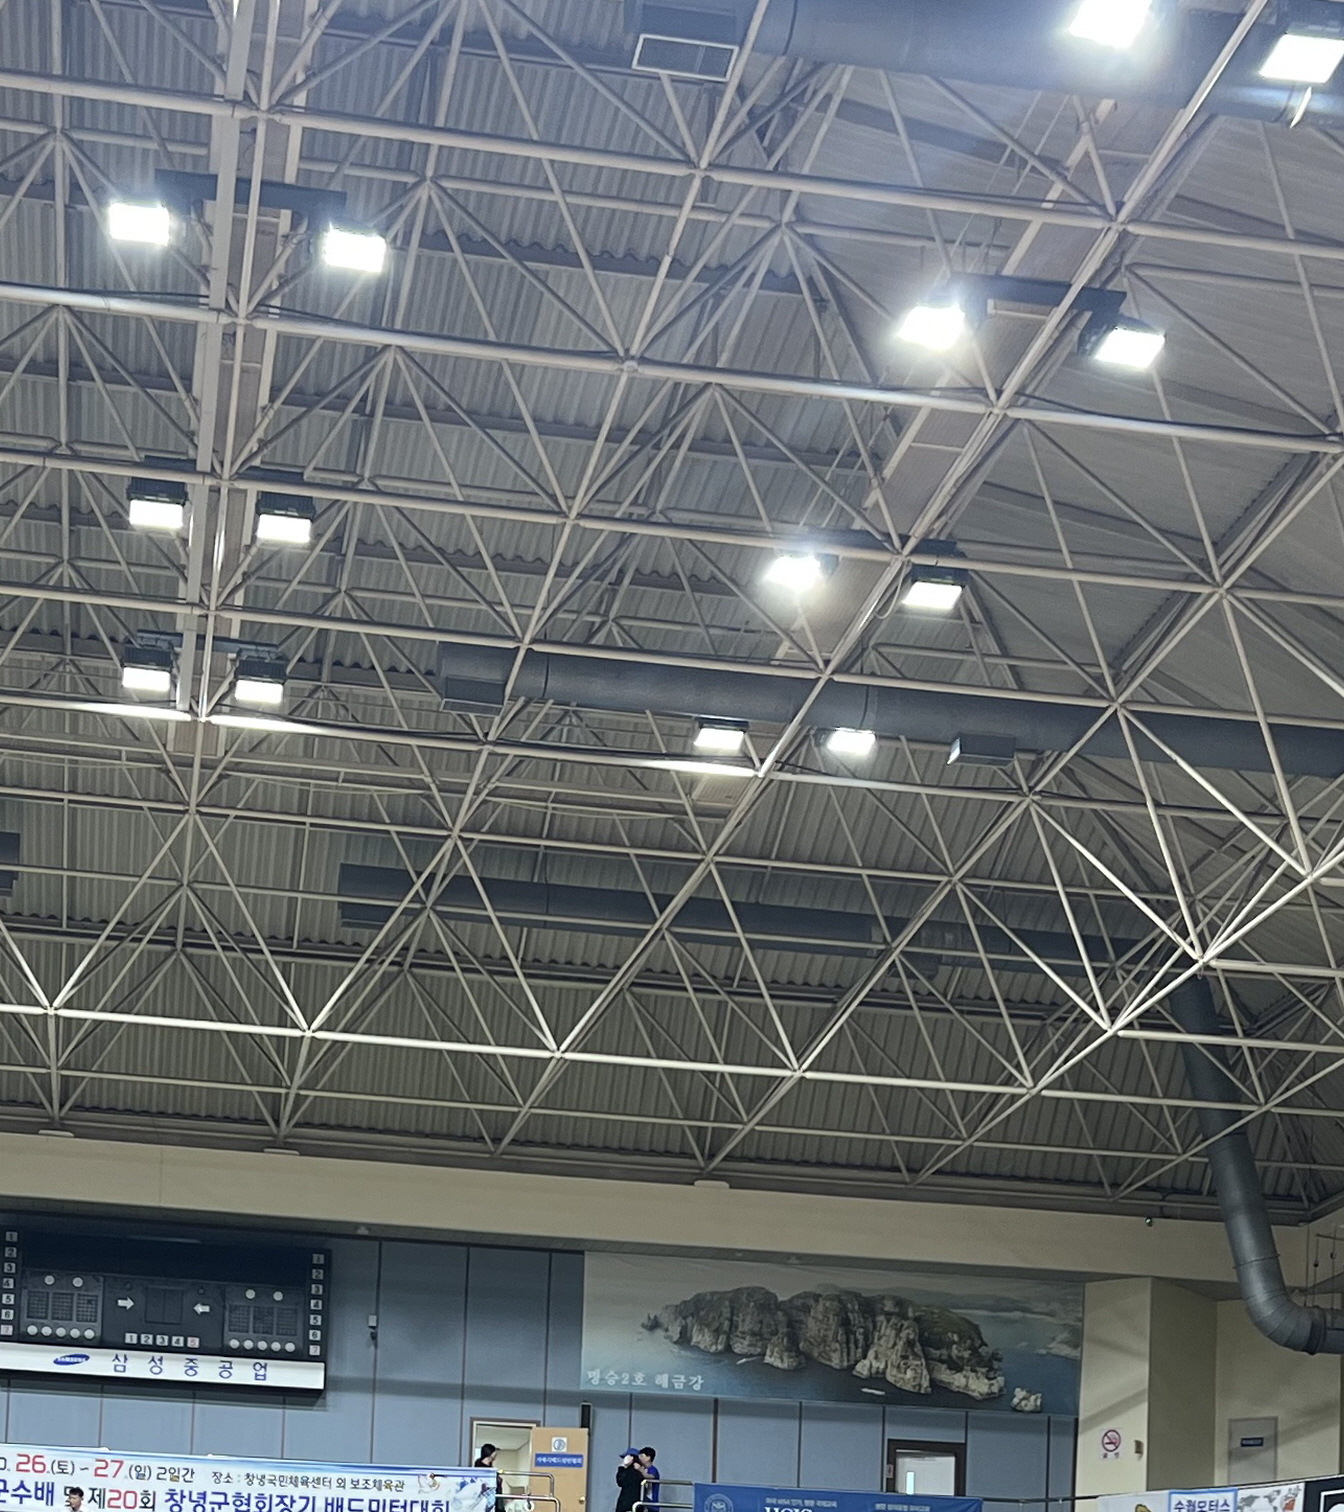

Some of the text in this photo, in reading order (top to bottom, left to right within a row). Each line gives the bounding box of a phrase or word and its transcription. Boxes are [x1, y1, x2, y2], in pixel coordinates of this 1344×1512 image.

[156, 1467, 195, 1484] 2일간
[350, 1477, 406, 1494] 보조체육관
[88, 1485, 156, 1511] 제20회
